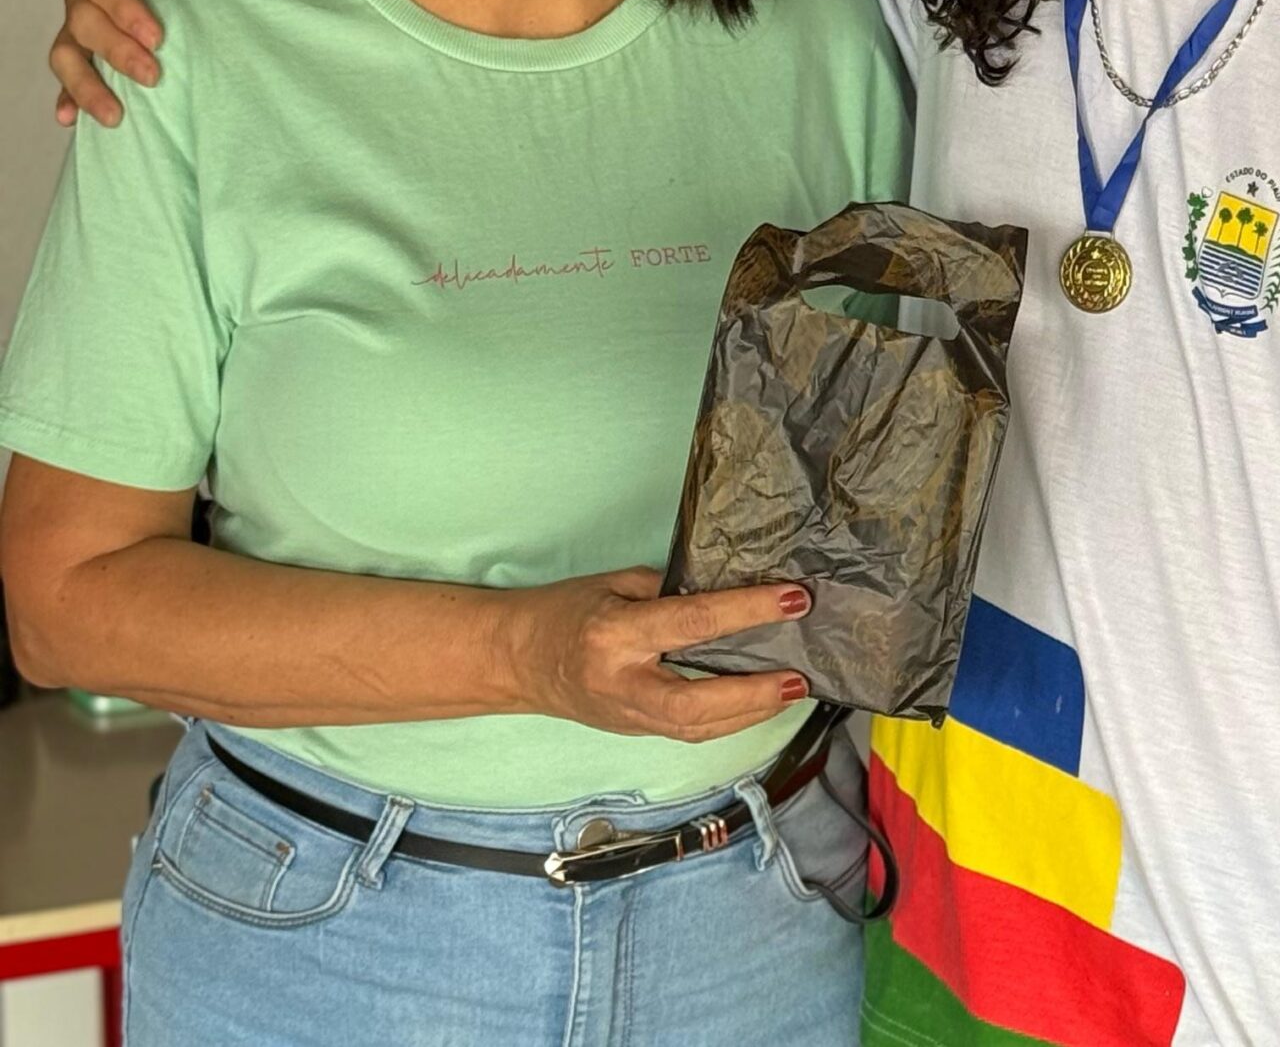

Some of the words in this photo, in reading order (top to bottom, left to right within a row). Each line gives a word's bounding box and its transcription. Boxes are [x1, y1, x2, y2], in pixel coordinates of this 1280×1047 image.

[1225, 167, 1254, 183] ESTADO
[1255, 168, 1268, 180] DO
[630, 244, 712, 268] FORTE
